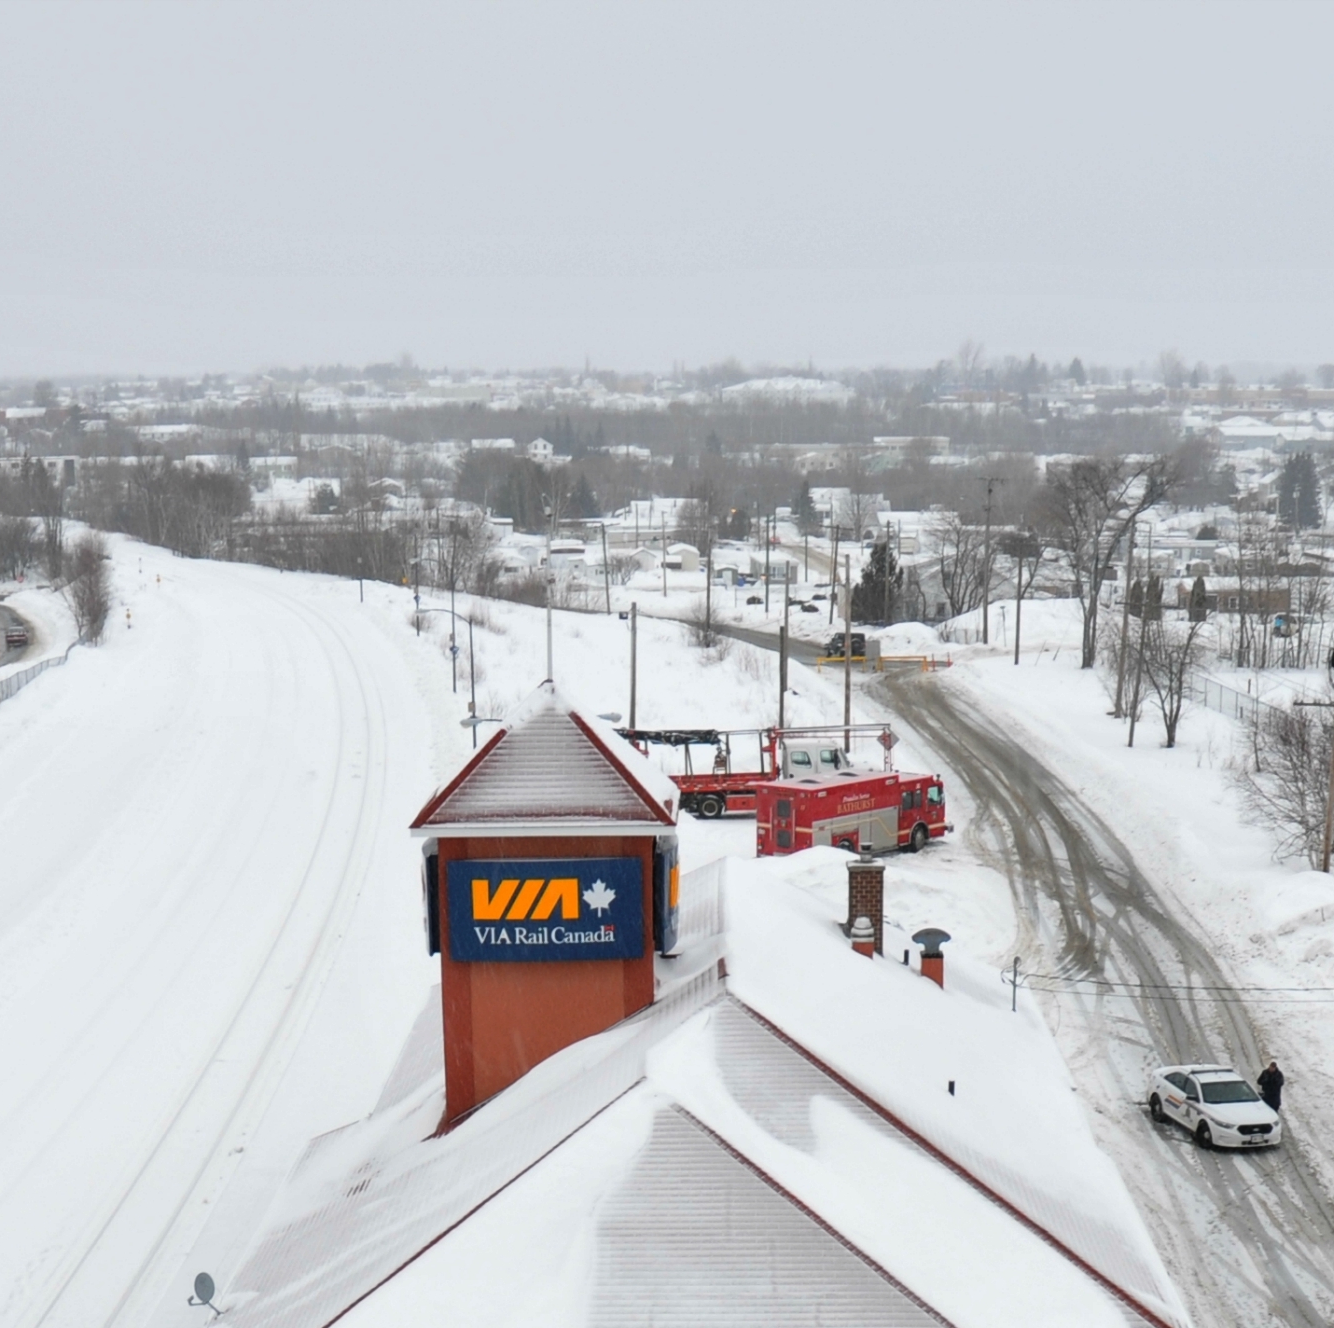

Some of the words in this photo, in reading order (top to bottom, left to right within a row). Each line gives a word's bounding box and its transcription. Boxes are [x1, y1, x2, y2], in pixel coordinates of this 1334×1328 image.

[471, 879, 579, 920] VIA
[474, 927, 511, 945] VIA
[514, 926, 548, 945] Rail
[551, 925, 615, 944] Canada
